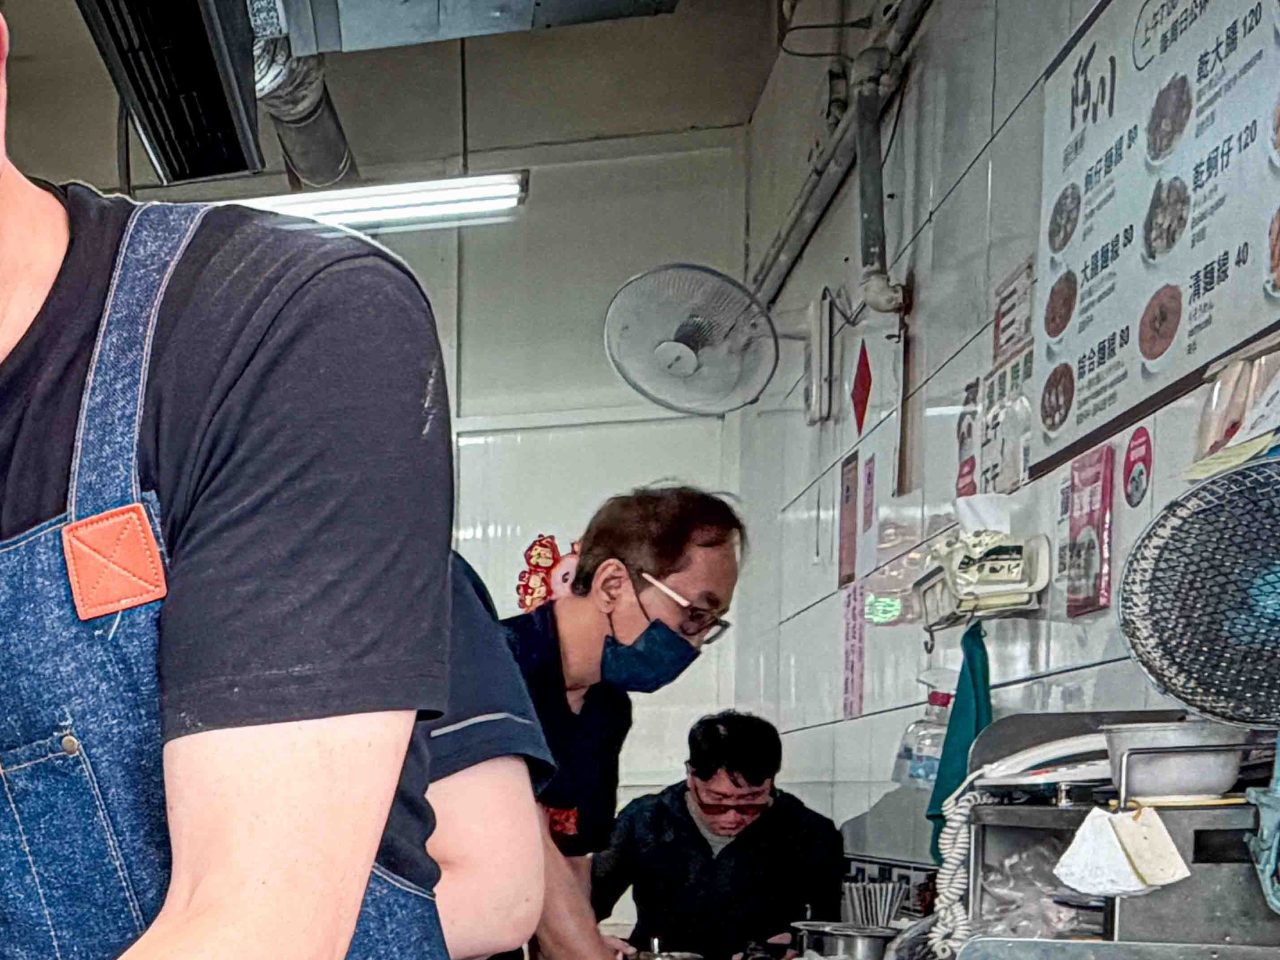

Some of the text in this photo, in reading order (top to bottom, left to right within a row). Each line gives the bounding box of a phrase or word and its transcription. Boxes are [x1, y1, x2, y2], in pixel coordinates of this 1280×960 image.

[1242, 2, 1262, 38] 120
[1238, 119, 1257, 153] 120
[1235, 241, 1249, 267] 40
